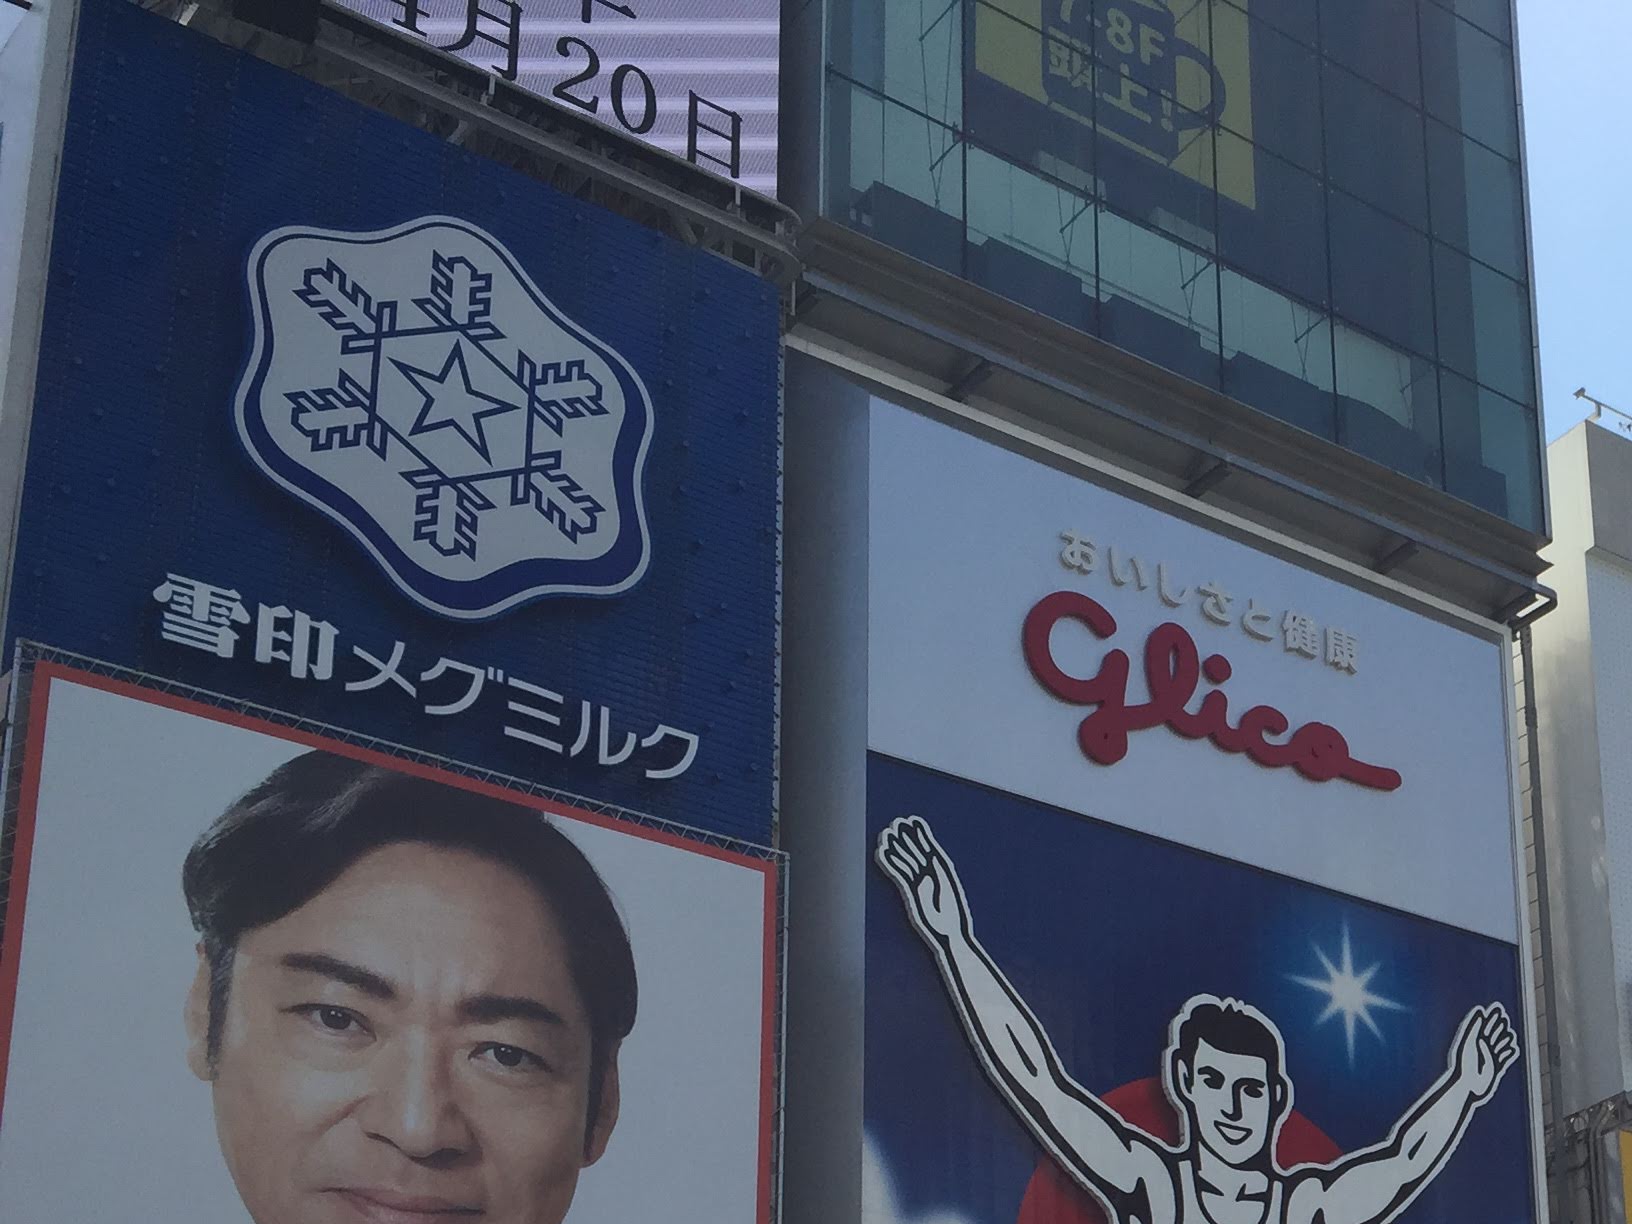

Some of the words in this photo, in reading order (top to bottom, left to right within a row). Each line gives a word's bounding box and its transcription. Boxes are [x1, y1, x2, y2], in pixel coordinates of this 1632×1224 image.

[153, 572, 700, 779] 雪印メグミルク
[1060, 528, 1358, 674] おいしさと健康
